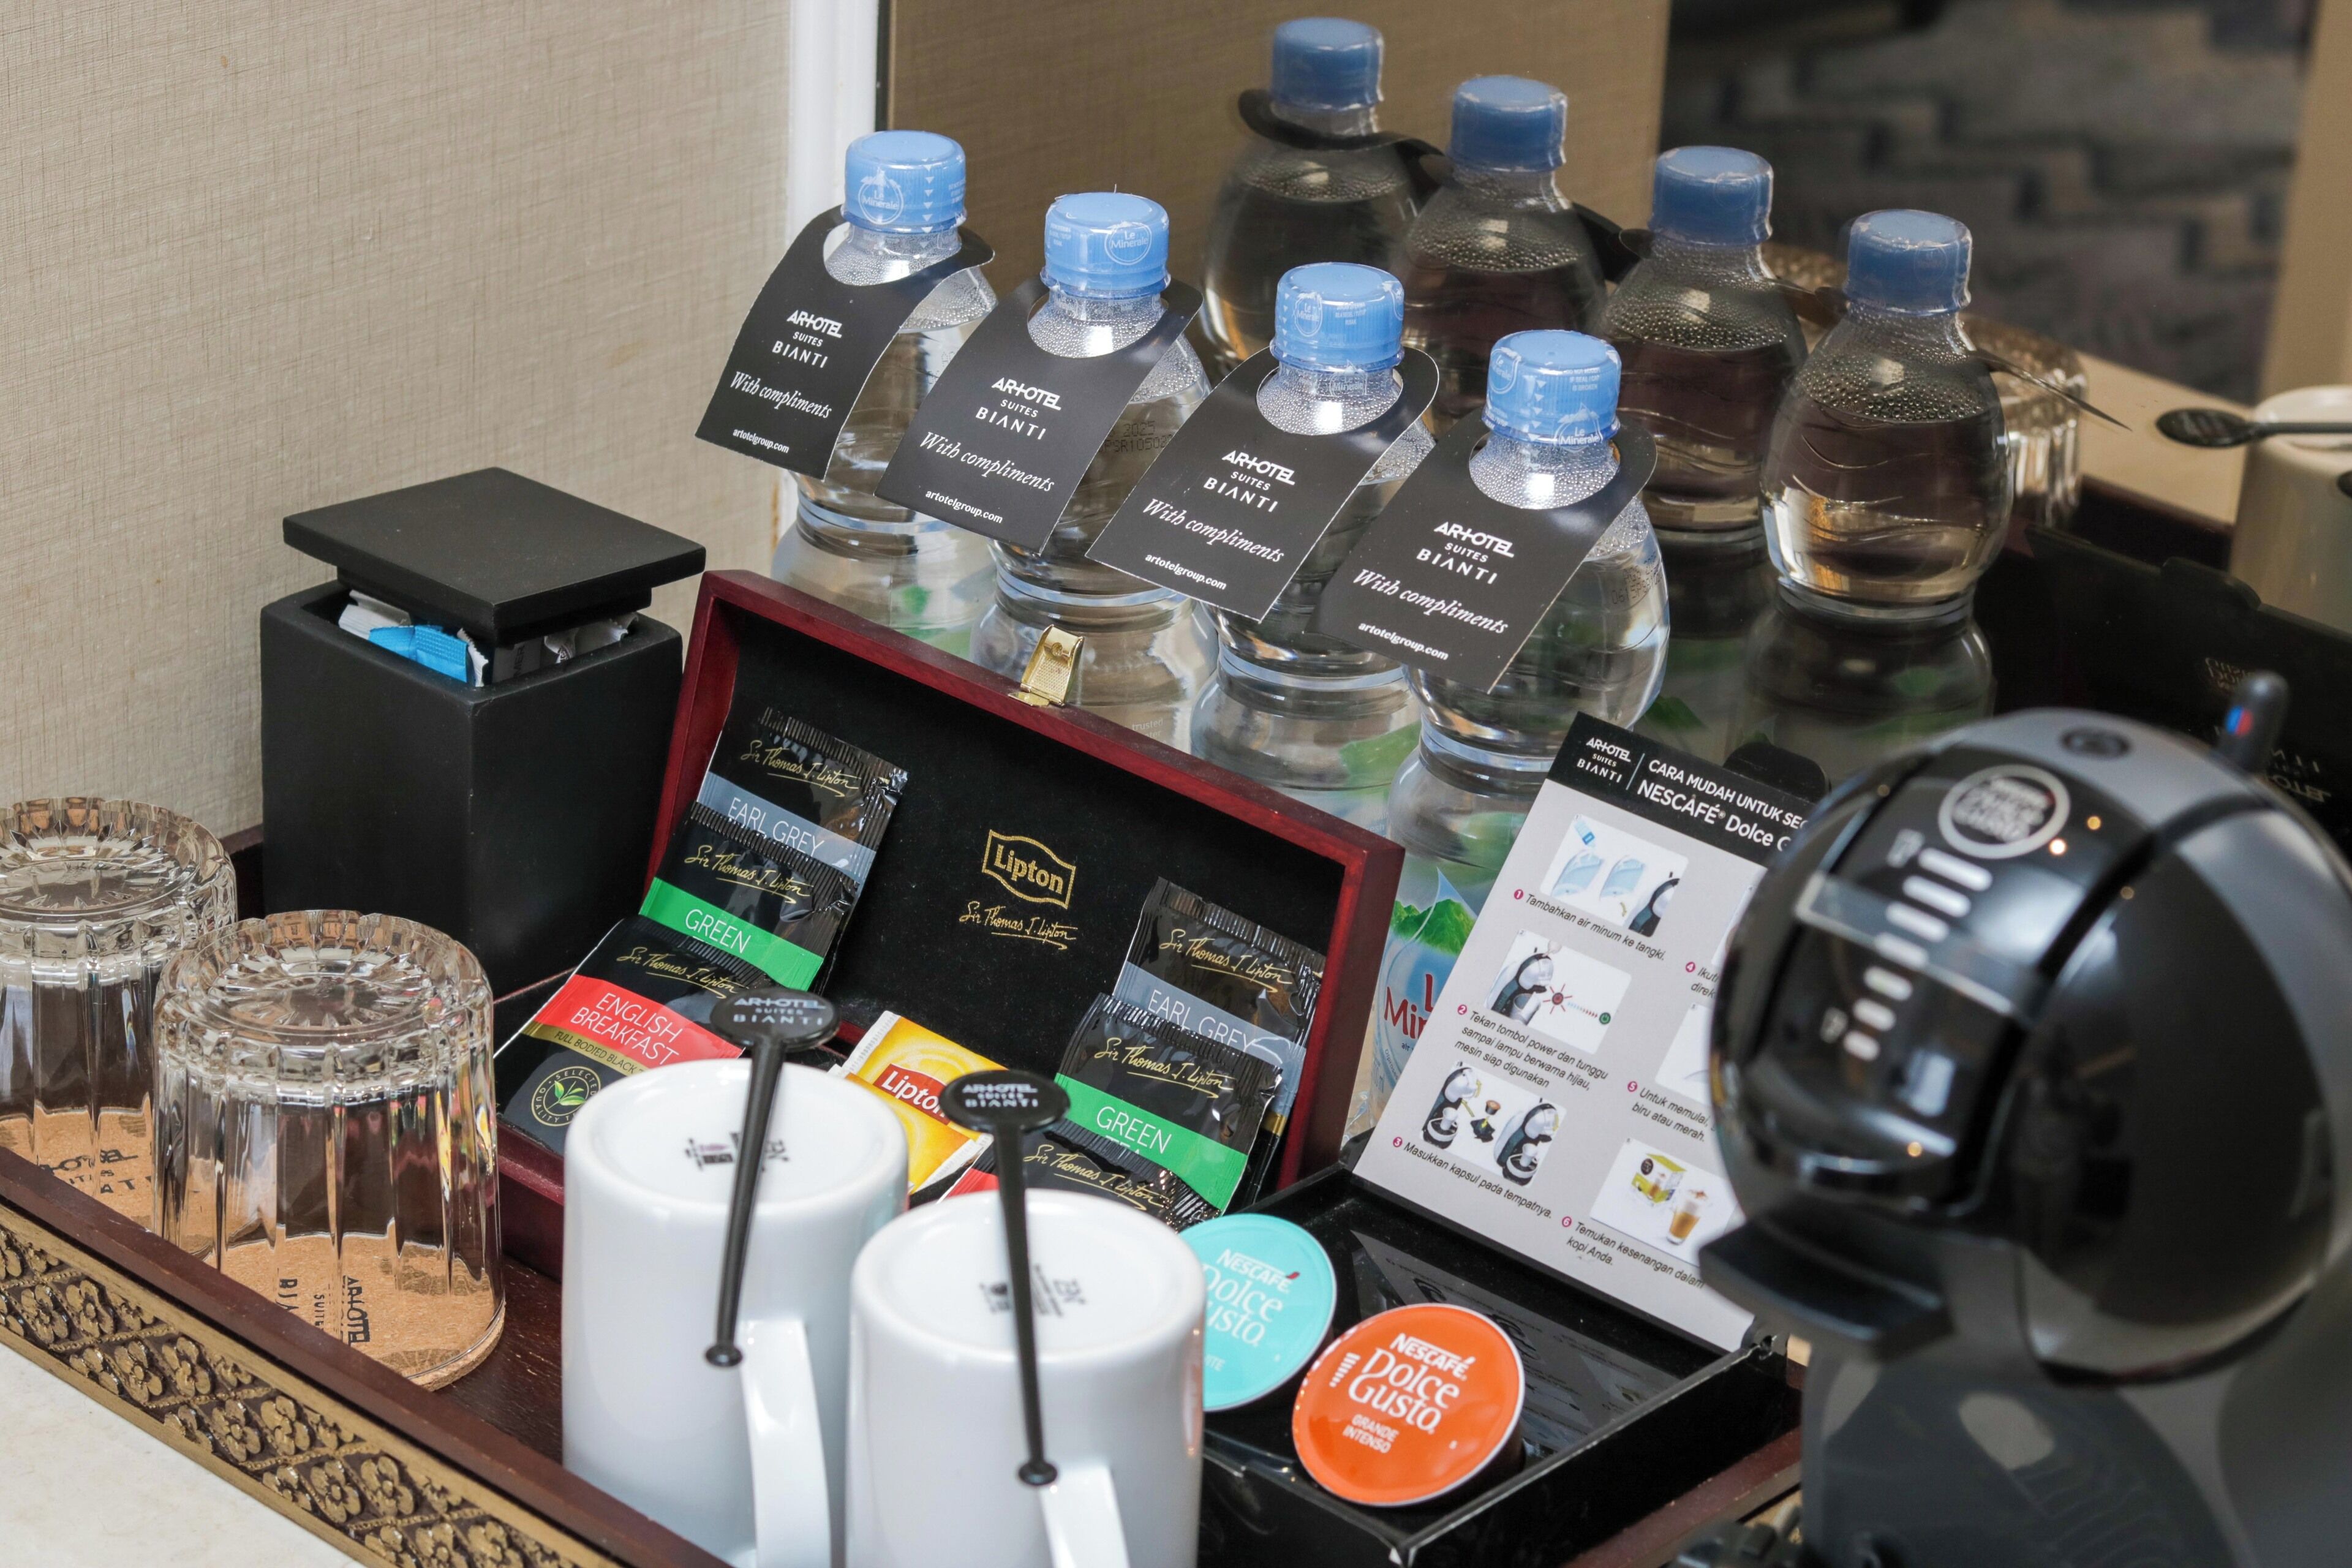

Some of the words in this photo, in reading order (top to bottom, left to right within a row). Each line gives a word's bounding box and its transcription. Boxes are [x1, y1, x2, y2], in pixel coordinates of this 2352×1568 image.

[862, 195, 899, 210] Minerale
[874, 190, 884, 200] Le
[1111, 238, 1148, 250] Minerale
[1125, 231, 1136, 239] Le
[772, 341, 828, 368] BIANTI
[793, 331, 823, 347] SUITES
[730, 371, 760, 394] With
[760, 385, 832, 419] compliments
[1000, 399, 1038, 418] SUITES
[733, 428, 790, 453] artotelgroup.com
[975, 406, 1046, 440] BIANTI
[1123, 421, 1156, 437] 2025
[1561, 435, 1599, 445] Minerale
[1575, 427, 1585, 436] Le
[919, 431, 959, 458] With
[960, 450, 1055, 492] compliments
[1203, 477, 1278, 513] BIANTI
[1231, 471, 1270, 491] SUITES
[925, 489, 1003, 524] artotelgroup.com
[1143, 499, 1184, 527] With
[1186, 518, 1285, 562] compliments
[1145, 553, 1227, 590] artotelgroup.com
[1416, 548, 1498, 585] BIANTI
[1445, 542, 1489, 563] SUITES
[1353, 569, 1399, 597] With
[1400, 588, 1509, 635] compliments
[1358, 622, 1449, 660] artotelgroup.com
[1132, 717, 1163, 731] trusted
[761, 747, 804, 774] Thomas
[816, 768, 861, 791] Lipton
[1577, 758, 1623, 783] BIANTI
[1592, 753, 1617, 767] SUITES
[1649, 760, 1684, 784] CARA
[1686, 774, 1736, 802] MUDAH
[1736, 793, 1783, 821] UNTUK
[728, 797, 769, 840] EARL
[772, 820, 826, 858] GREY
[1725, 814, 1774, 846] Dolce
[709, 854, 757, 881] Thomas
[767, 874, 814, 897] Lipton
[994, 844, 1064, 895] Lipton
[685, 909, 751, 954] GREEN
[984, 905, 1023, 930] Thomas
[1038, 919, 1078, 944] Lipton
[1526, 894, 1577, 923] Tambahkan
[1578, 916, 1591, 929] air
[1591, 924, 1622, 942] minum
[1623, 935, 1635, 948] ke
[1635, 941, 1665, 962] tangki.
[639, 953, 688, 975] Thomas
[696, 971, 750, 994] Lipton
[1183, 938, 1230, 966] Thomas
[1245, 960, 1292, 985] Lipton
[594, 992, 683, 1043] ENGLISH
[733, 1014, 823, 1025] BIANTI
[1148, 989, 1193, 1031] EARL
[554, 1031, 574, 1044] FULL
[574, 1039, 607, 1059] BODIED
[606, 1054, 637, 1074] BLACK
[570, 1006, 679, 1066] BREAKFAST
[1401, 1042, 1411, 1052] air
[1469, 1011, 1496, 1030] Tekan
[1497, 1024, 1529, 1044] tombol
[1527, 1039, 1558, 1057] power
[1557, 1050, 1576, 1065] dan
[1576, 1060, 1608, 1080] tunggu
[1122, 1046, 1172, 1074] Thomas
[1185, 1066, 1234, 1091] Lipton
[1455, 1040, 1482, 1058] mesin
[1482, 1053, 1502, 1068] siap
[1503, 1062, 1550, 1088] digunakan
[1462, 1026, 1496, 1046] sampai
[1495, 1041, 1523, 1060] lampu
[1523, 1052, 1567, 1077] berwarna
[1566, 1071, 1591, 1091] hijau,
[556, 1069, 597, 1096] SELECTED
[535, 1087, 559, 1123] QUALITY
[965, 1099, 1039, 1107] BIANTI
[1632, 1102, 1651, 1117] biru
[1651, 1110, 1673, 1127] atau
[1673, 1121, 1705, 1142] merah.
[1639, 1087, 1667, 1107] Untuk
[1667, 1101, 1710, 1126] memulai,
[1096, 1106, 1172, 1155] GREEN
[1050, 1153, 1101, 1180] Thomas
[1404, 1142, 1449, 1170] Masukkan
[1449, 1163, 1480, 1185] kapsul
[1478, 1179, 1504, 1195] pada
[1504, 1189, 1552, 1219] tempatnya.
[1566, 1237, 1588, 1252] kopi
[1586, 1246, 1613, 1266] Anda.
[1574, 1221, 1616, 1249] Temukan
[1616, 1242, 1674, 1275] kesenangan
[1674, 1270, 1705, 1289] dalam
[1216, 1248, 1300, 1295] NESCAFÉ
[1207, 1300, 1265, 1347] sto
[1362, 1348, 1460, 1409] Dolce
[1349, 1374, 1441, 1434] Gusto
[1342, 1425, 1392, 1454] INTENSO
[1352, 1414, 1400, 1442] GRANDE
